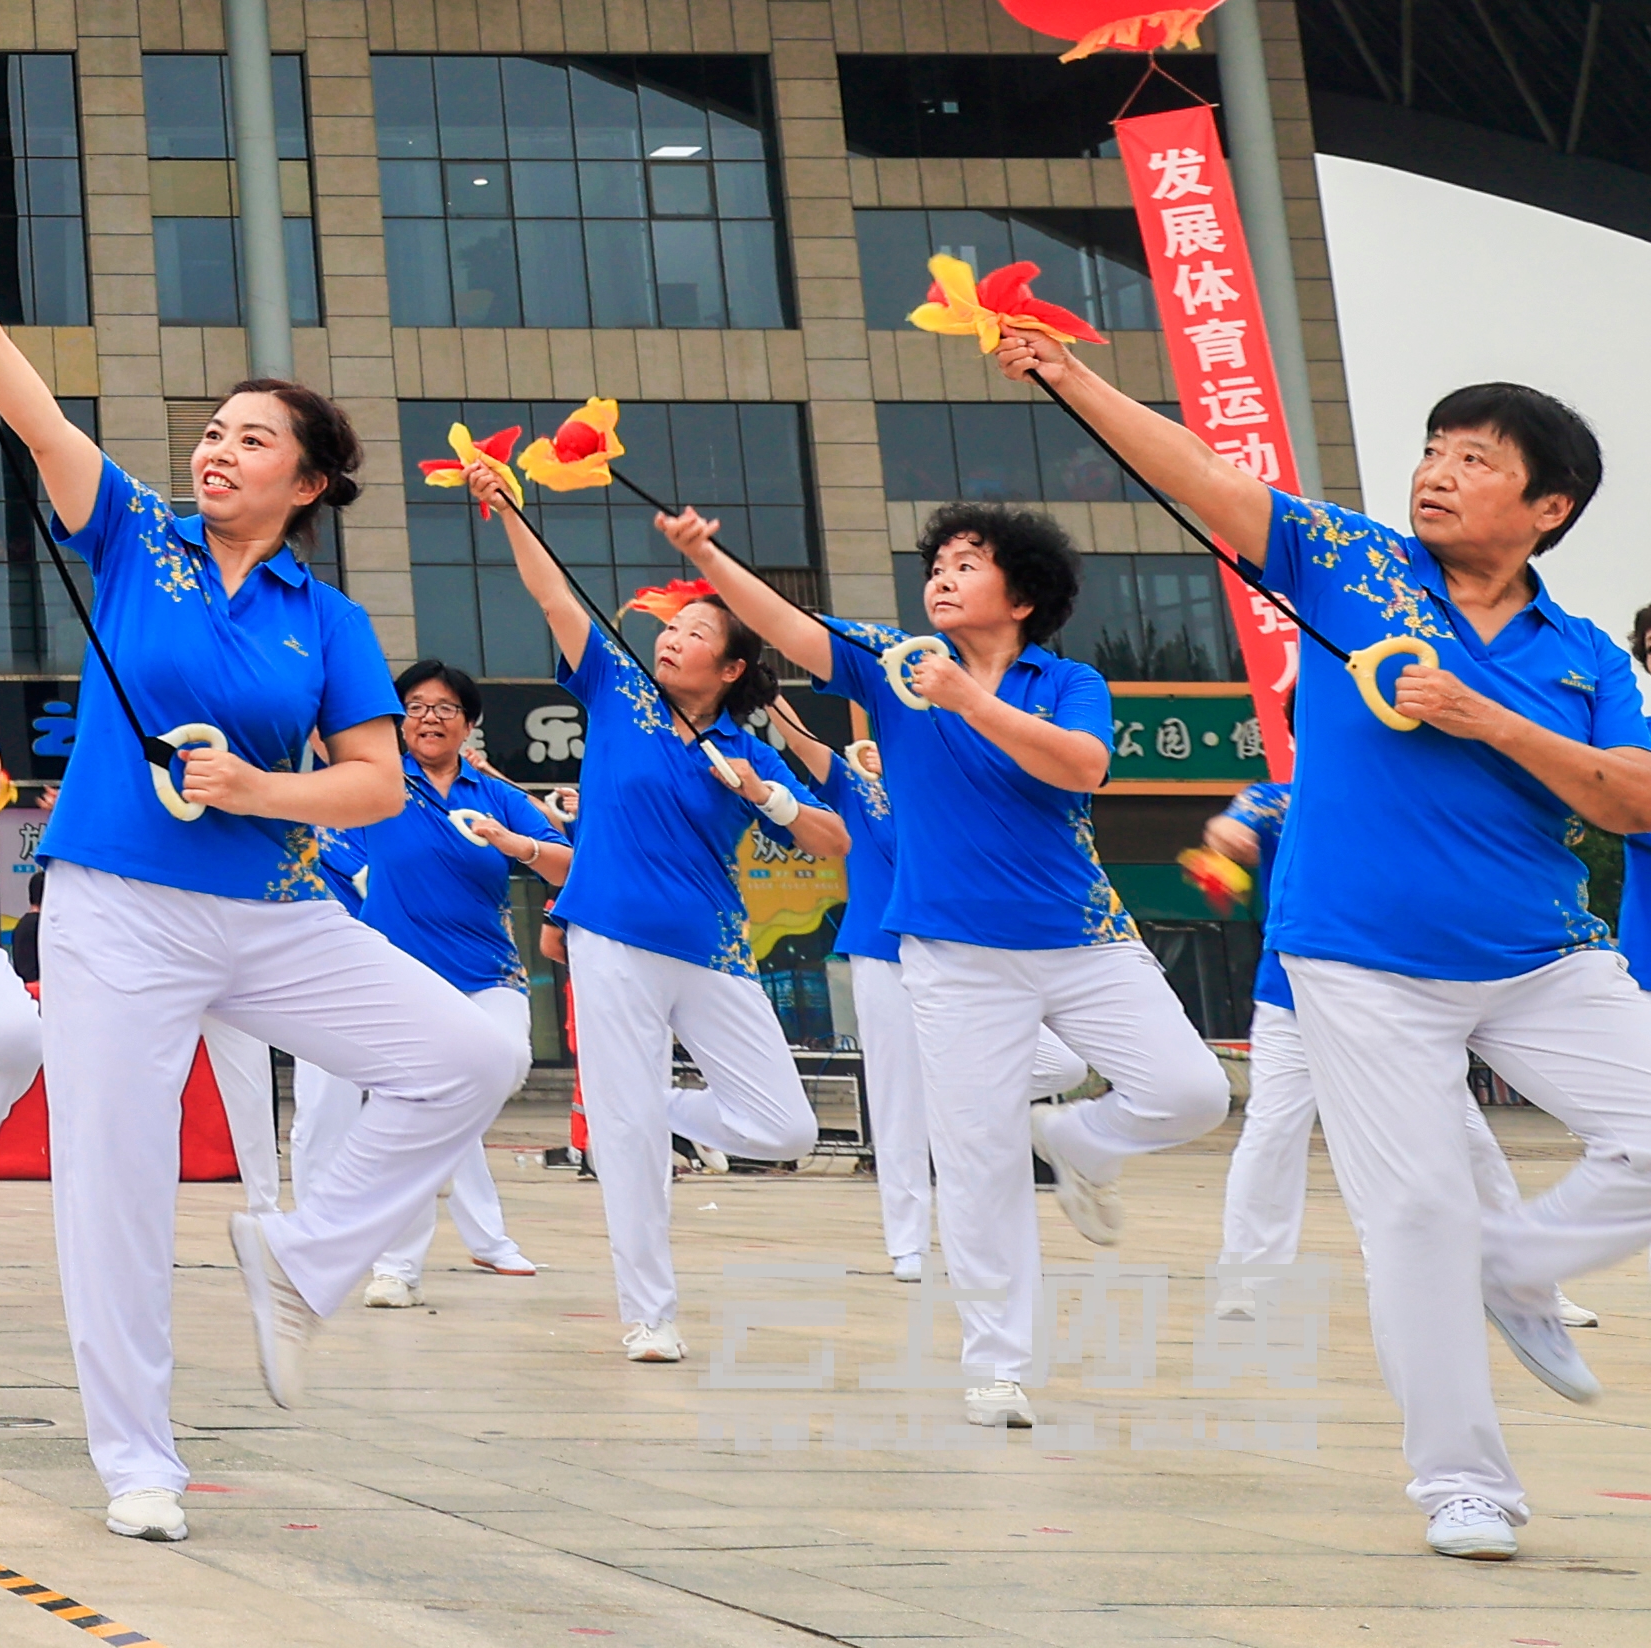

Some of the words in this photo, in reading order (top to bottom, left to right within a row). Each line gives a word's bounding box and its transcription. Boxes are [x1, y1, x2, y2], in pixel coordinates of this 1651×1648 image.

[1148, 147, 1281, 485] 发展体育运动
